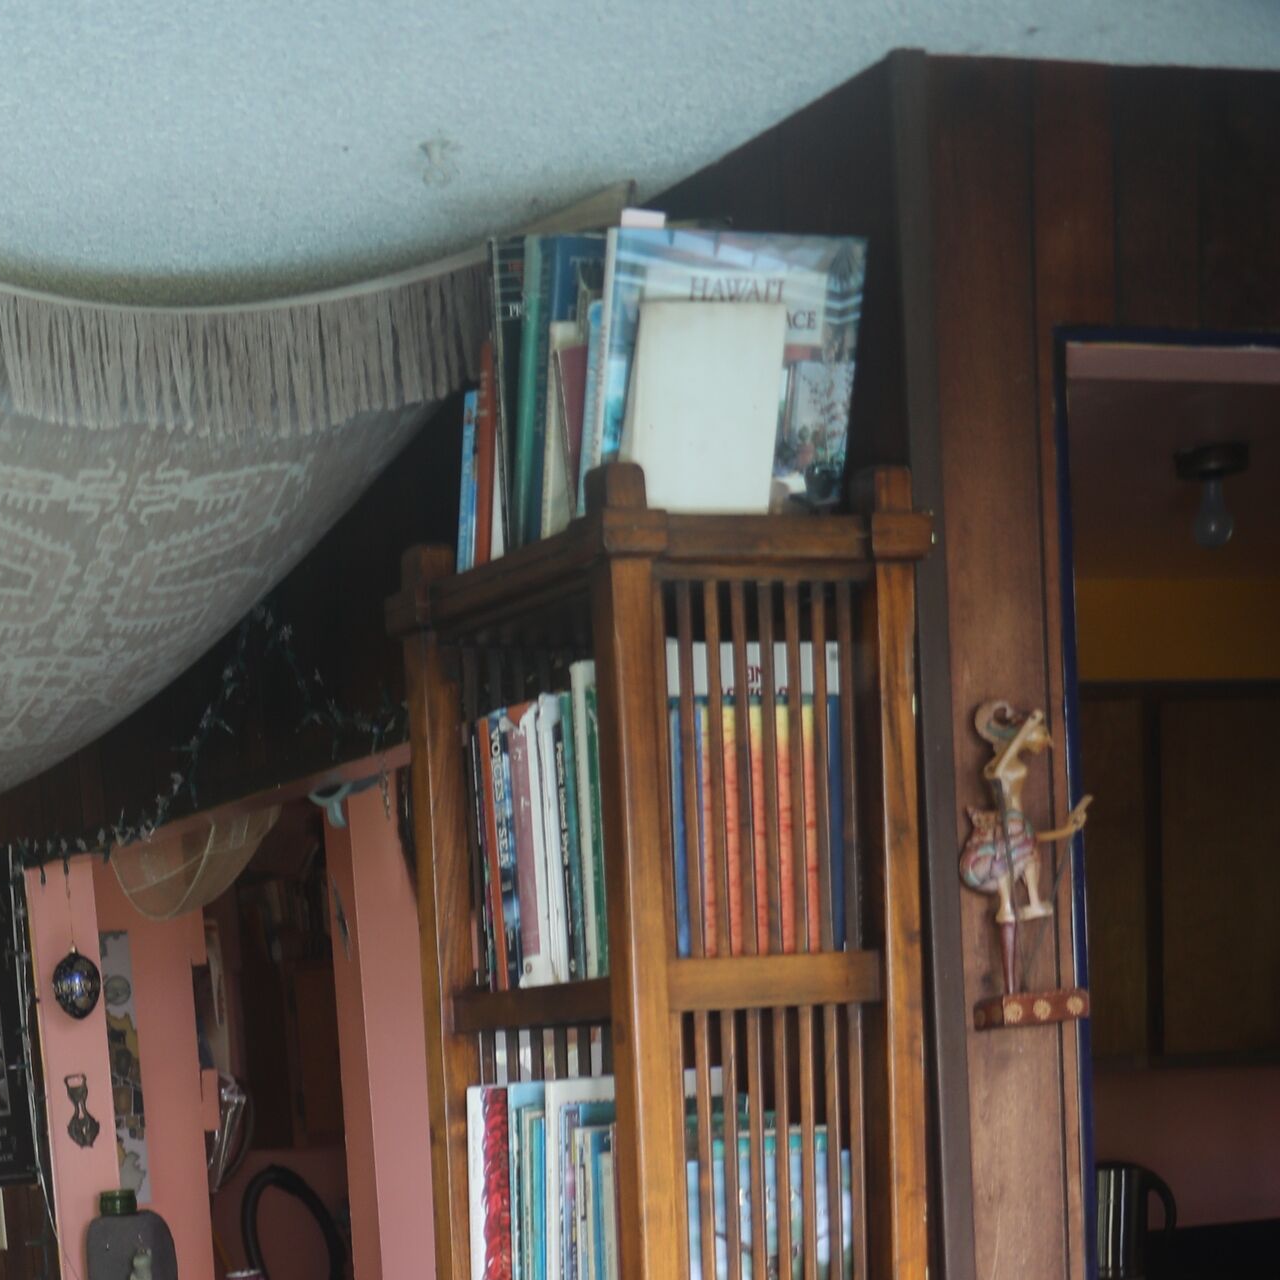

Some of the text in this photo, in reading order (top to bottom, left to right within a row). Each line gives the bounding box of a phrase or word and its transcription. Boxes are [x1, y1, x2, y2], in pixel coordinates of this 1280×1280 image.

[689, 275, 785, 302] HAWAI'I
[555, 741, 564, 786] Pacific
[491, 727, 505, 802] VOICES
[498, 827, 510, 868] SEA
[558, 787, 567, 830] Island
[561, 830, 569, 866] Style
